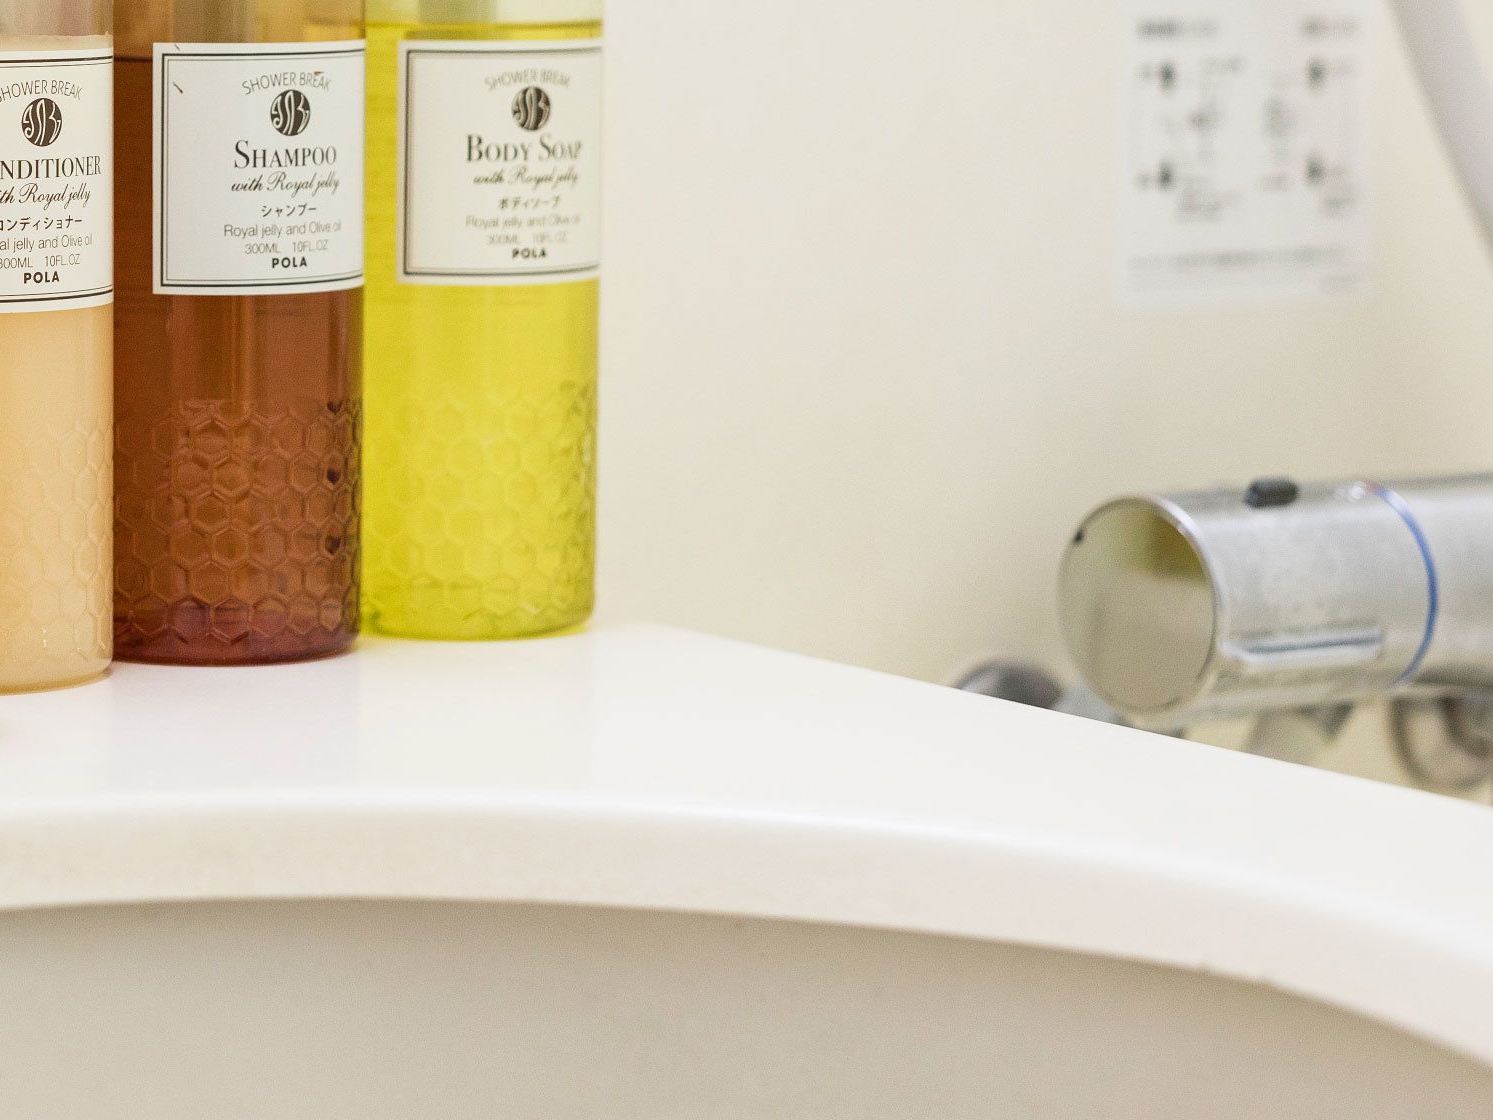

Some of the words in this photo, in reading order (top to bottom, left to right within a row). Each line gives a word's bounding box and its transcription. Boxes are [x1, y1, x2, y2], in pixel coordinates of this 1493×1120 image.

[51, 80, 83, 100] BREAK
[242, 72, 297, 96] SHOWER
[299, 71, 332, 92] BREAK
[234, 139, 337, 169] SHAMPOO
[466, 134, 531, 162] BODY
[231, 174, 265, 192] with
[266, 171, 313, 198] Royal
[313, 171, 340, 197] jelly
[18, 182, 67, 211] Royal
[64, 182, 92, 209] jelly
[224, 224, 258, 240] Royal
[261, 223, 283, 239] jelly
[285, 223, 306, 236] and
[308, 221, 331, 234] Olive
[12, 236, 35, 253] jelly
[38, 234, 58, 249] and
[60, 233, 83, 248] Olive
[84, 233, 93, 246] oil
[245, 243, 281, 255] 300ML
[512, 247, 547, 259] POLA
[44, 253, 81, 268] 10FL.OZ
[271, 256, 307, 269] POLA
[23, 271, 60, 284] POLA
